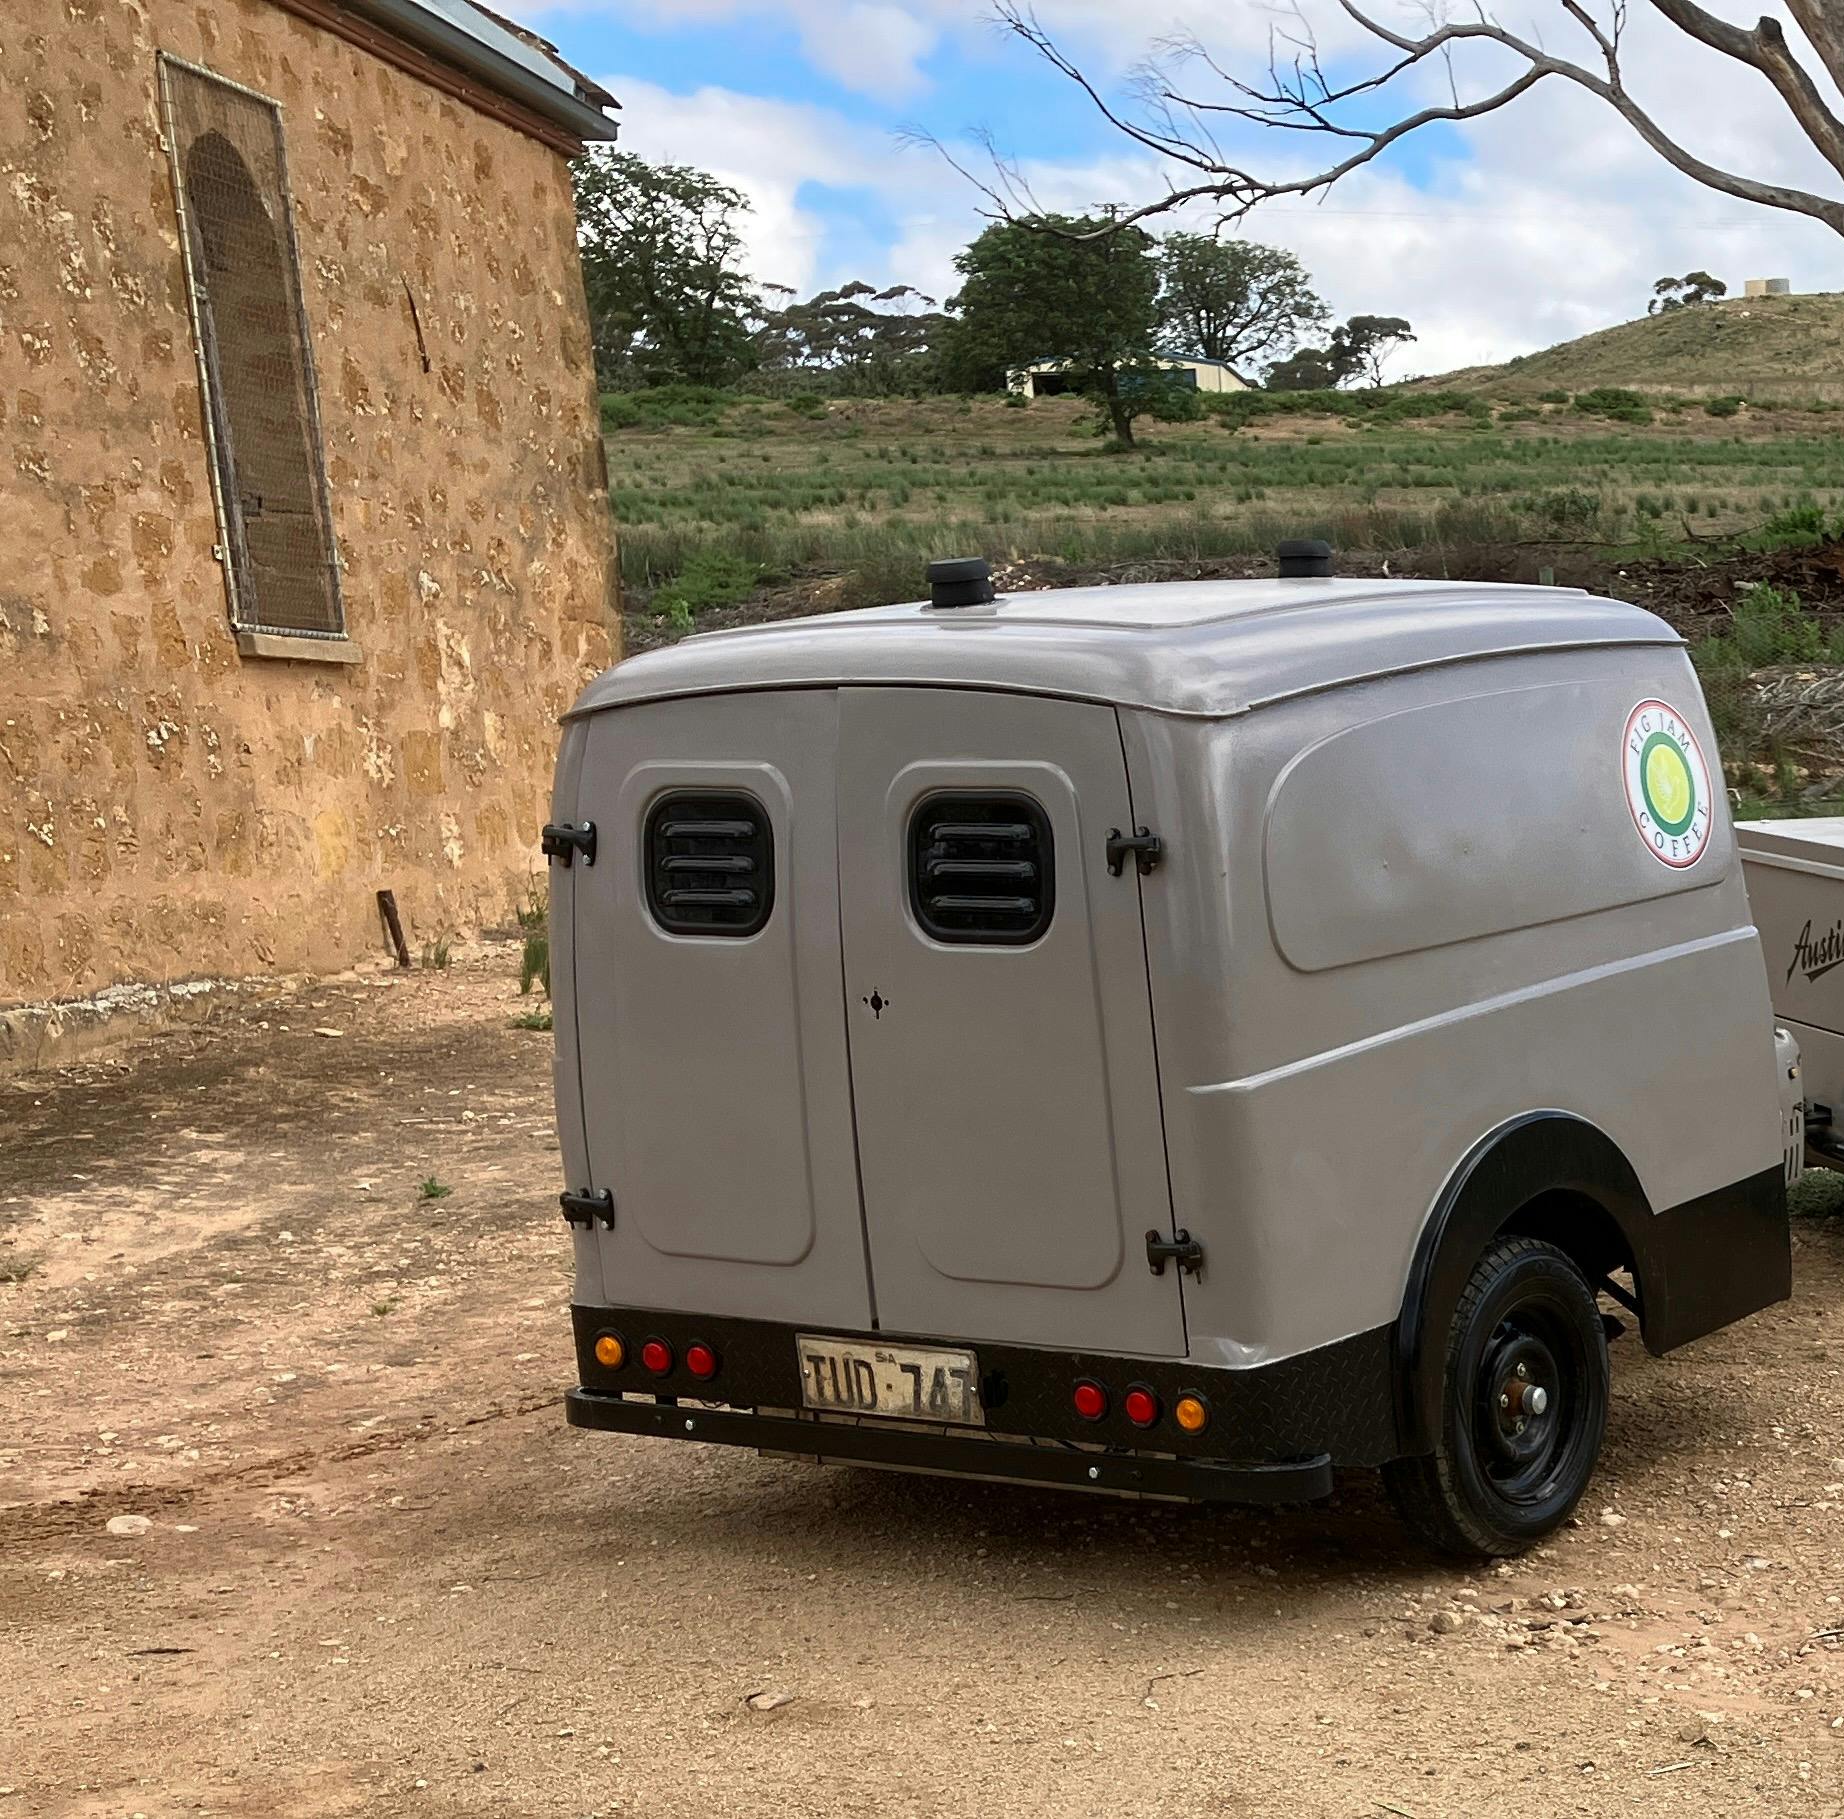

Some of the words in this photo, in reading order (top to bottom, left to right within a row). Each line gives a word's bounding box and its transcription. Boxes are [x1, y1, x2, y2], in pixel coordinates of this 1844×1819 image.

[1630, 714, 1651, 754] FIG
[1659, 712, 1691, 753] JAM
[1639, 801, 1709, 858] COFFEE
